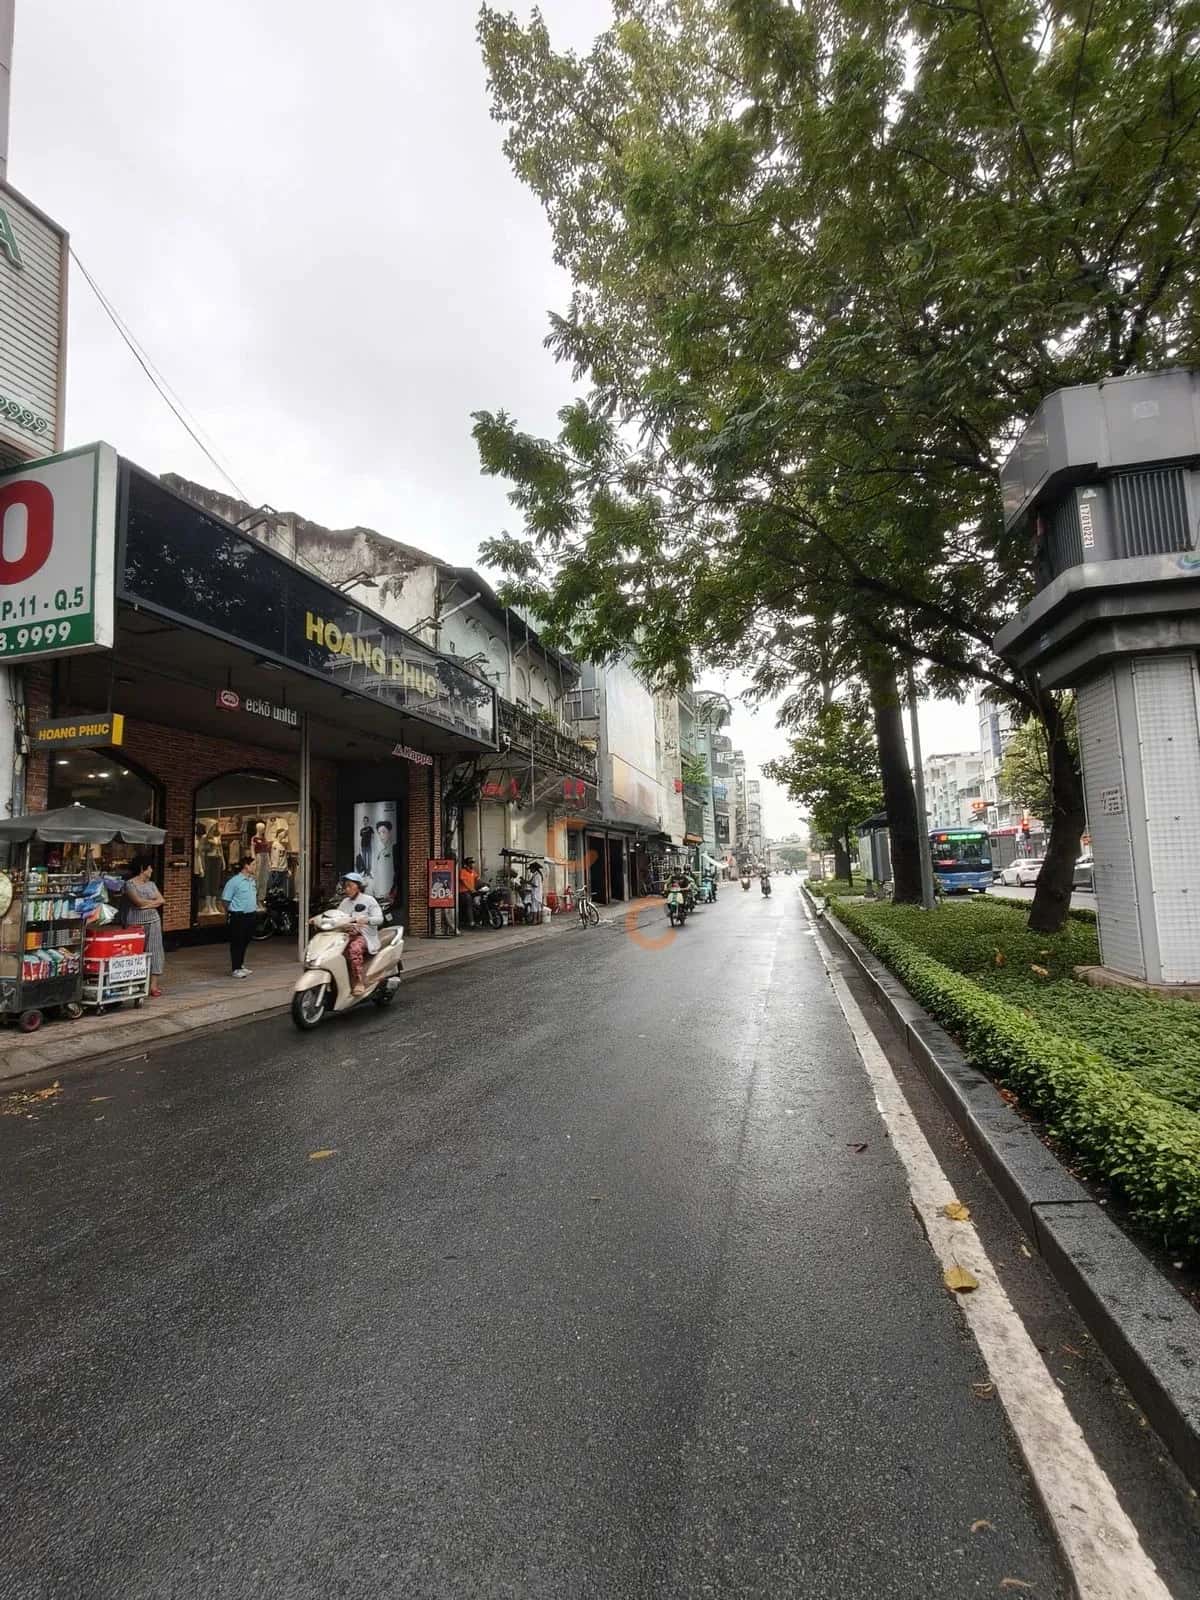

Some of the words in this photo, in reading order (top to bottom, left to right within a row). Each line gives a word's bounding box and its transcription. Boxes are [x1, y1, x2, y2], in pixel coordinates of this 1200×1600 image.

[54, 586, 84, 611] Q.5
[305, 611, 386, 675] HOANG
[38, 726, 76, 741] HOANG
[79, 723, 110, 737] PHUC
